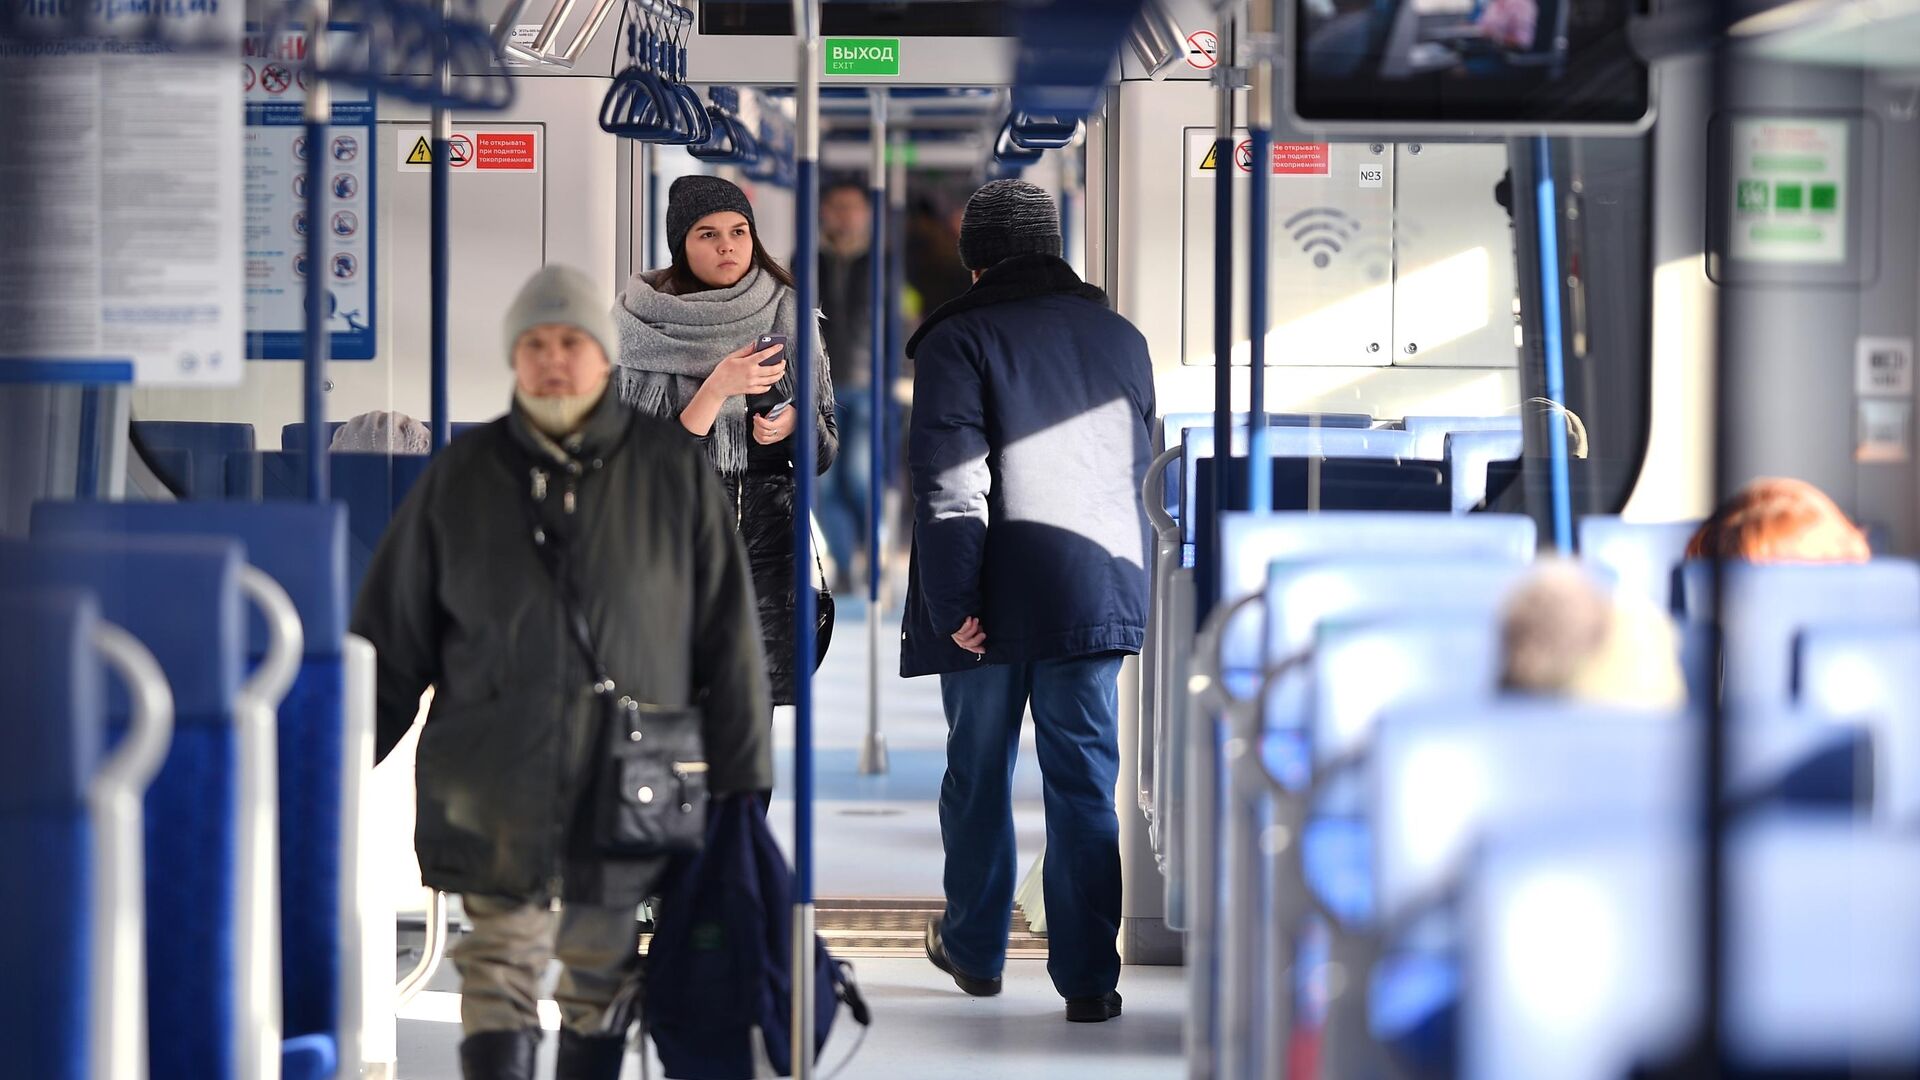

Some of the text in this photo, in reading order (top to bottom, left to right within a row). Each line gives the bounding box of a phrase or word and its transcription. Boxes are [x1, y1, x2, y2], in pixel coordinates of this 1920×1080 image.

[833, 47, 894, 62] ВЫХОД
[833, 62, 854, 70] EXIT
[1360, 171, 1382, 181] №3
